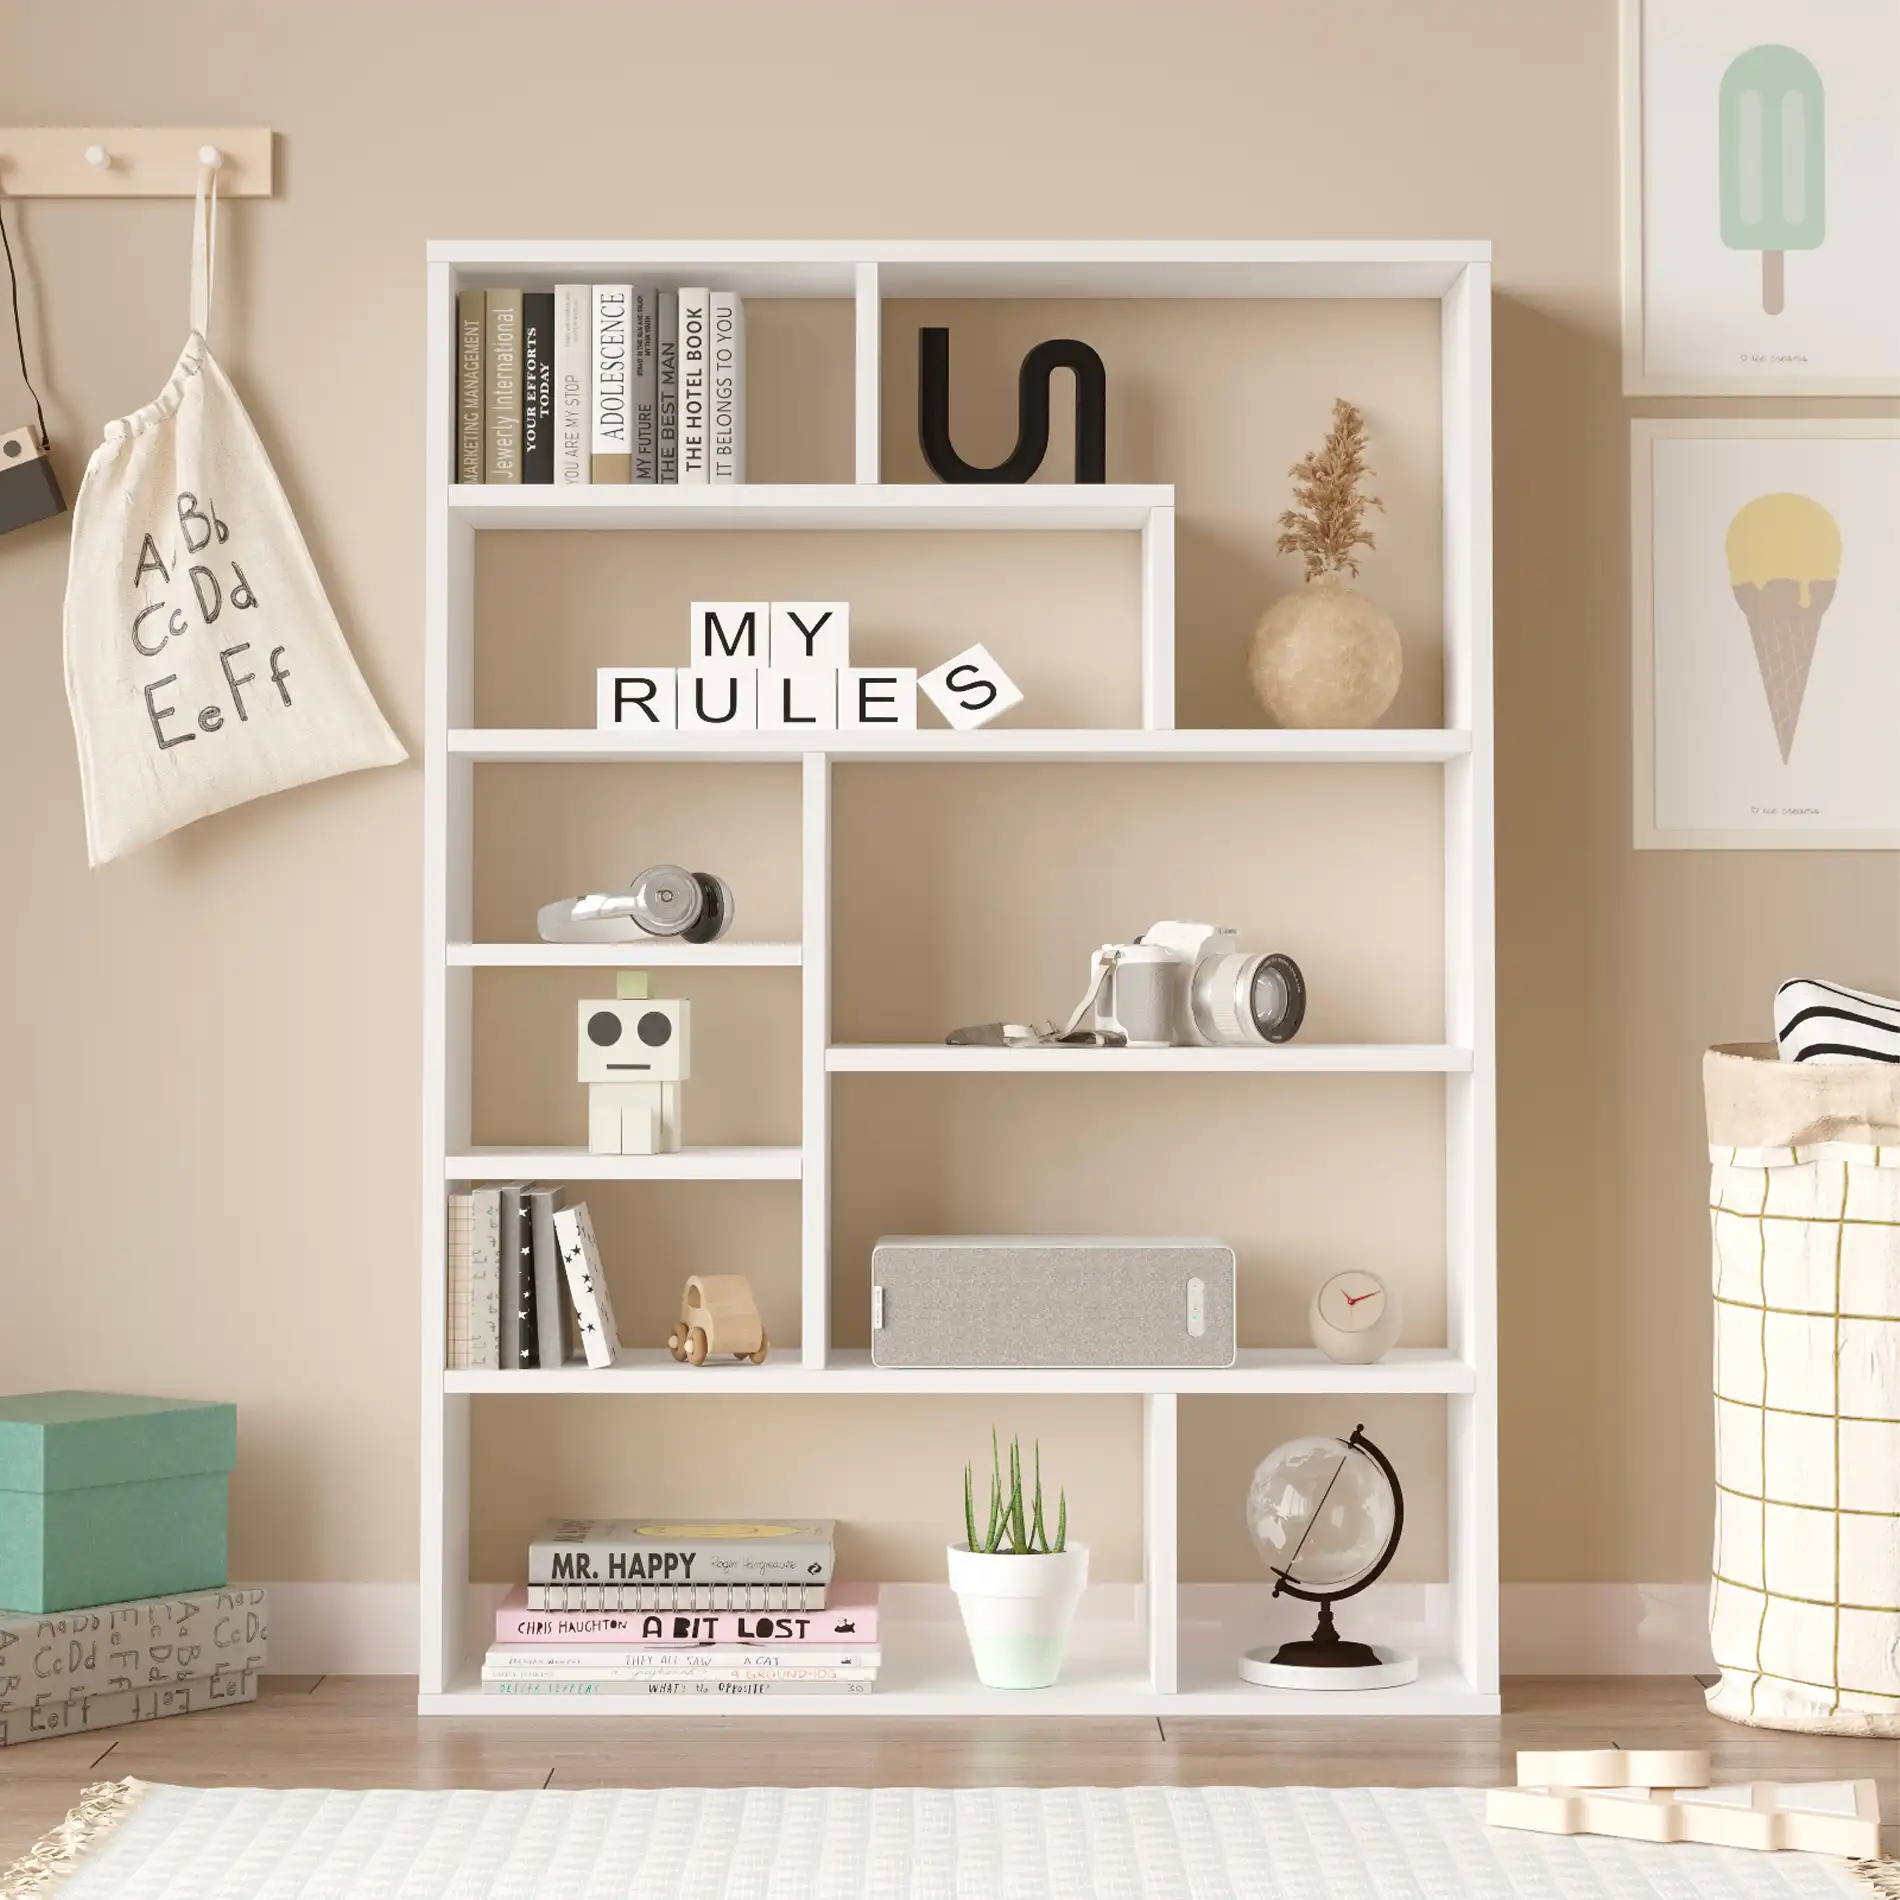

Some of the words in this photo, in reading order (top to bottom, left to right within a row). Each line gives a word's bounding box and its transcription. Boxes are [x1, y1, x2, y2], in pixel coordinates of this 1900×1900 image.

[686, 307, 702, 361] BOOK
[716, 307, 732, 343] YOU
[463, 319, 479, 408] MANAGEMENT
[491, 308, 514, 410] International
[526, 326, 537, 401] EFFORTS
[600, 292, 625, 441] ADOLESCENCE
[661, 342, 675, 387] MAN
[716, 348, 732, 372] TO
[539, 361, 550, 419] TODAY
[564, 374, 580, 407] STOP
[686, 368, 702, 429] HOTEL
[526, 406, 537, 453] YOUR
[564, 409, 580, 428] MY
[638, 403, 651, 455] FUTURE
[661, 391, 675, 440] BEST
[716, 377, 732, 455] BELONGS
[463, 410, 479, 483] MARKETING
[491, 416, 519, 478] Jewerly
[564, 432, 580, 458] ARE
[661, 447, 675, 484] THE
[686, 436, 702, 473] THE
[564, 461, 580, 485] YOU
[636, 458, 651, 479] MY
[716, 461, 732, 477] IT
[703, 611, 834, 657] MY
[613, 664, 998, 724] RULES
[551, 1552, 599, 1580] MR.
[608, 1551, 697, 1580] HAPPY
[517, 1620, 552, 1636] CHRIS
[558, 1619, 628, 1635] HAUGHTON
[642, 1615, 663, 1639] A
[672, 1616, 720, 1639] BIT
[737, 1617, 811, 1640] LOST
[625, 1654, 653, 1666] THEY
[660, 1654, 678, 1665] ALL
[687, 1655, 712, 1667] SAW
[744, 1656, 752, 1665] A
[755, 1656, 780, 1666] CAT
